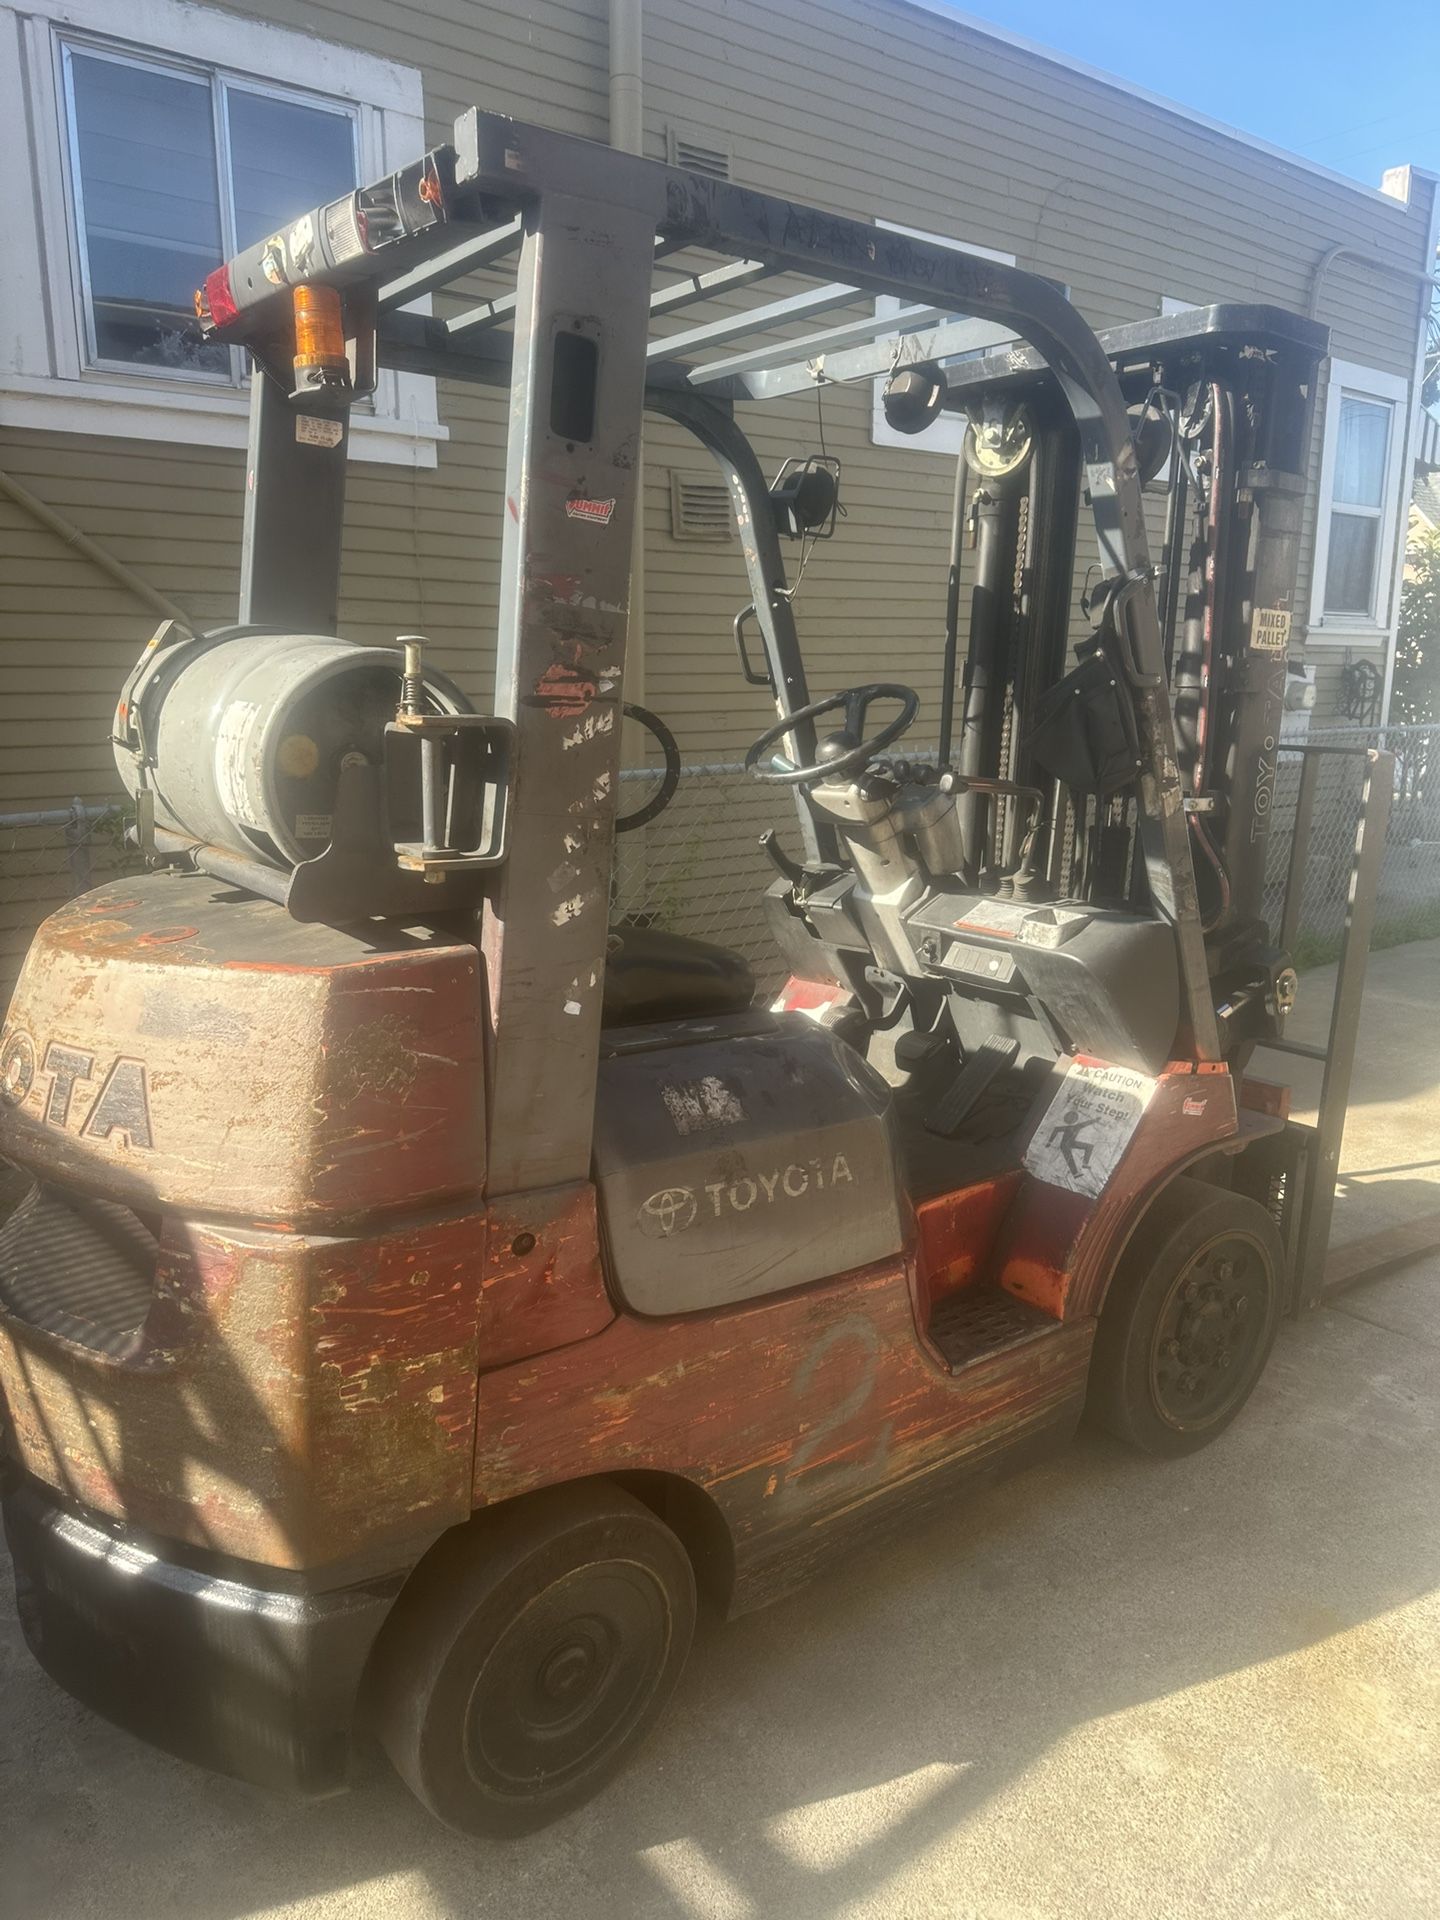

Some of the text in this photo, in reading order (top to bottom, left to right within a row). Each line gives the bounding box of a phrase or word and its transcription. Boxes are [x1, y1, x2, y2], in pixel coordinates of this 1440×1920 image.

[1260, 613, 1286, 629] MIXED
[1256, 630, 1286, 646] PALLET
[1094, 1069, 1142, 1090] CAUTION
[1083, 1082, 1125, 1103] Watch
[1067, 1093, 1129, 1120] Your Step!
[705, 1152, 853, 1217] TOYOTA
